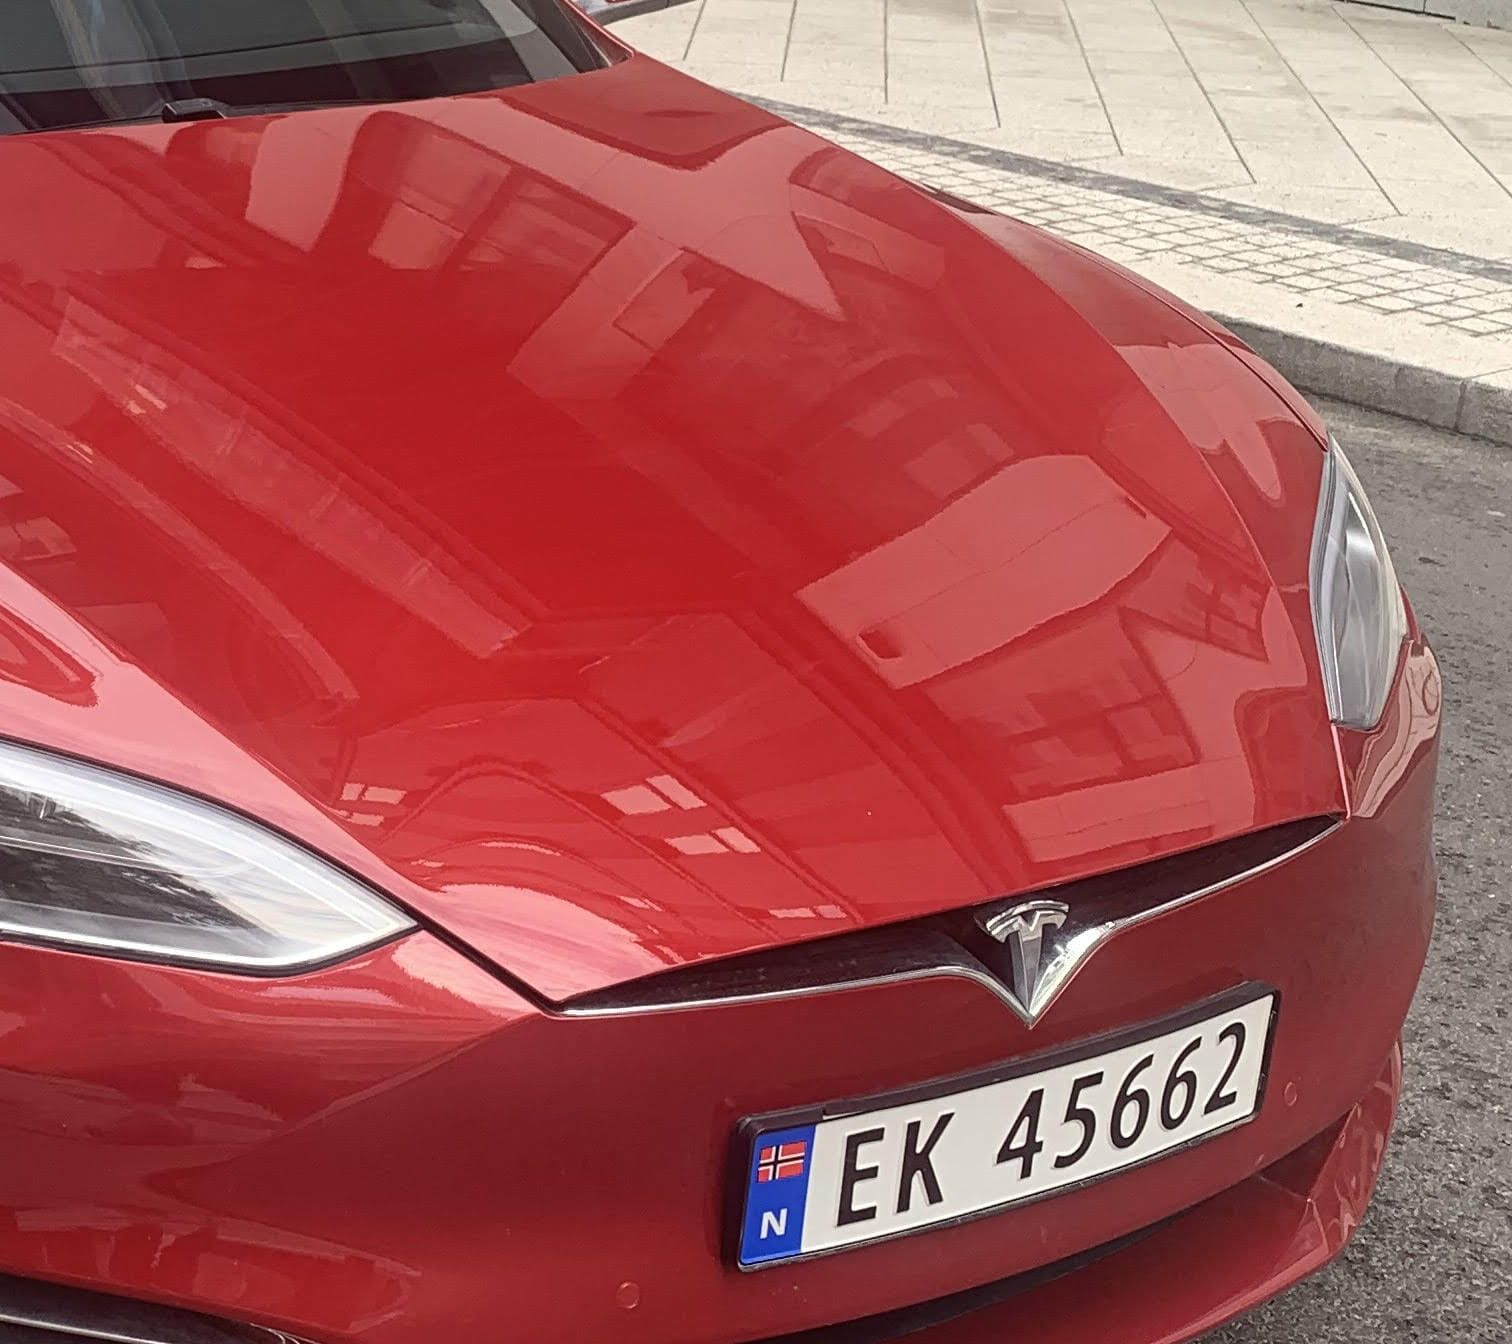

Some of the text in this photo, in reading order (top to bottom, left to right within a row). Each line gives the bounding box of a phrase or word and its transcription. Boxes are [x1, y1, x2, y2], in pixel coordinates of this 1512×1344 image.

[838, 1022, 1246, 1226] EK 45662
[760, 1208, 787, 1238] N
